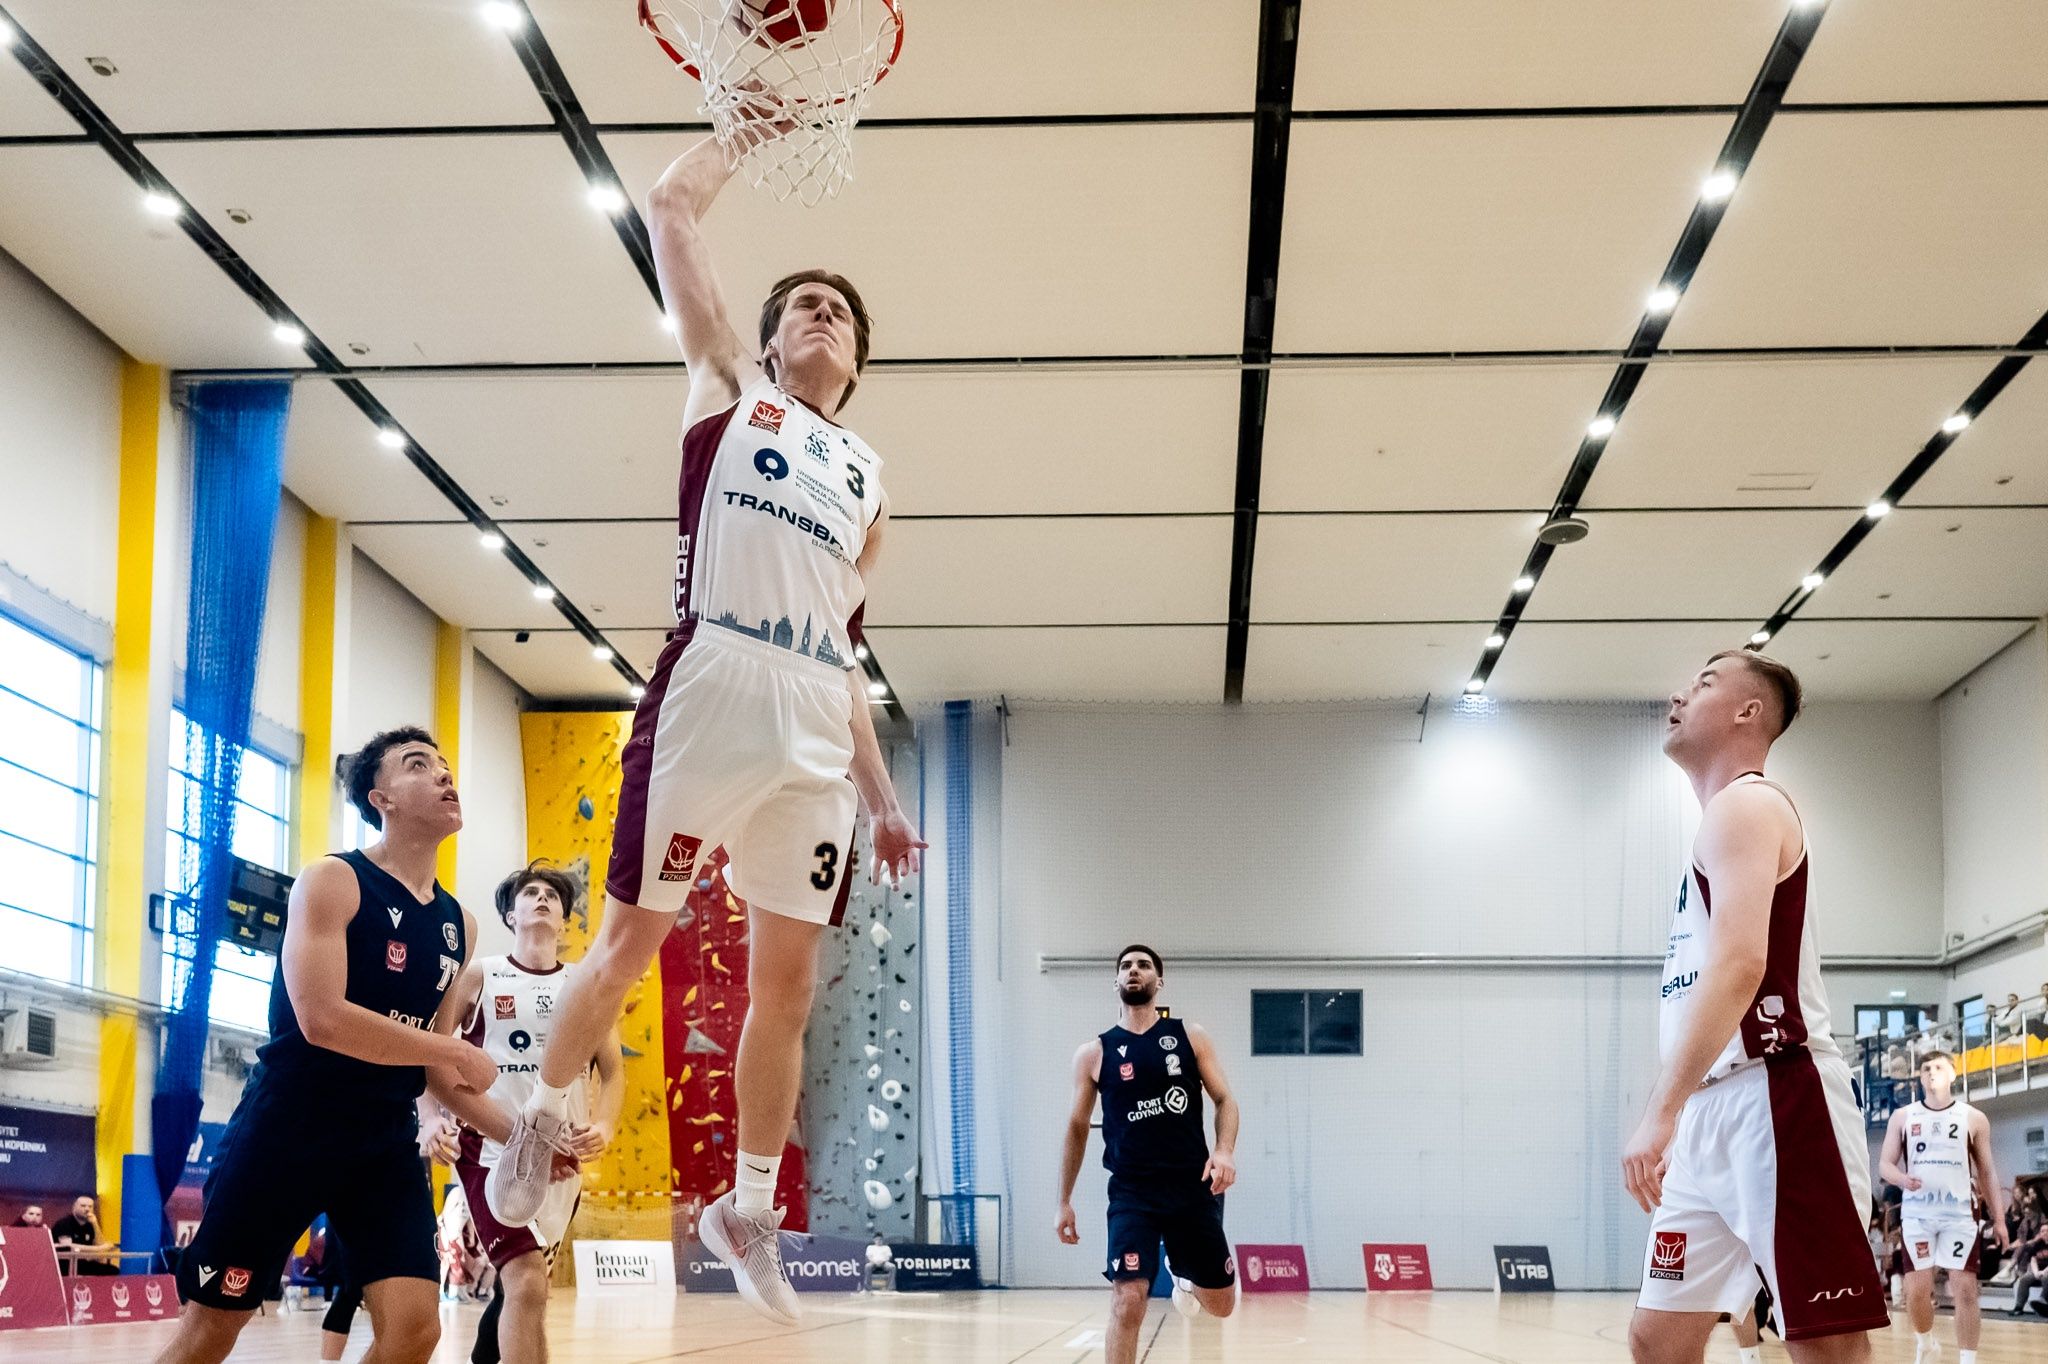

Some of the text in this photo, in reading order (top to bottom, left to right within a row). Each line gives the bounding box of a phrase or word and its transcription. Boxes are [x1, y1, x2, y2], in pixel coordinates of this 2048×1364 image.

[805, 444, 829, 465] UMK
[846, 463, 865, 499] 3
[810, 841, 838, 890] 3
[1165, 1053, 1182, 1076] 2
[1137, 1097, 1162, 1110] PORT
[1127, 1106, 1165, 1121] GDYNIA
[1949, 1123, 1959, 1139] 2
[1953, 1241, 1964, 1258] 2
[595, 1251, 649, 1266] leman
[894, 1257, 972, 1270] TORIMPEX
[597, 1266, 646, 1278] invest
[1651, 1270, 1681, 1280] PZKOSZ
